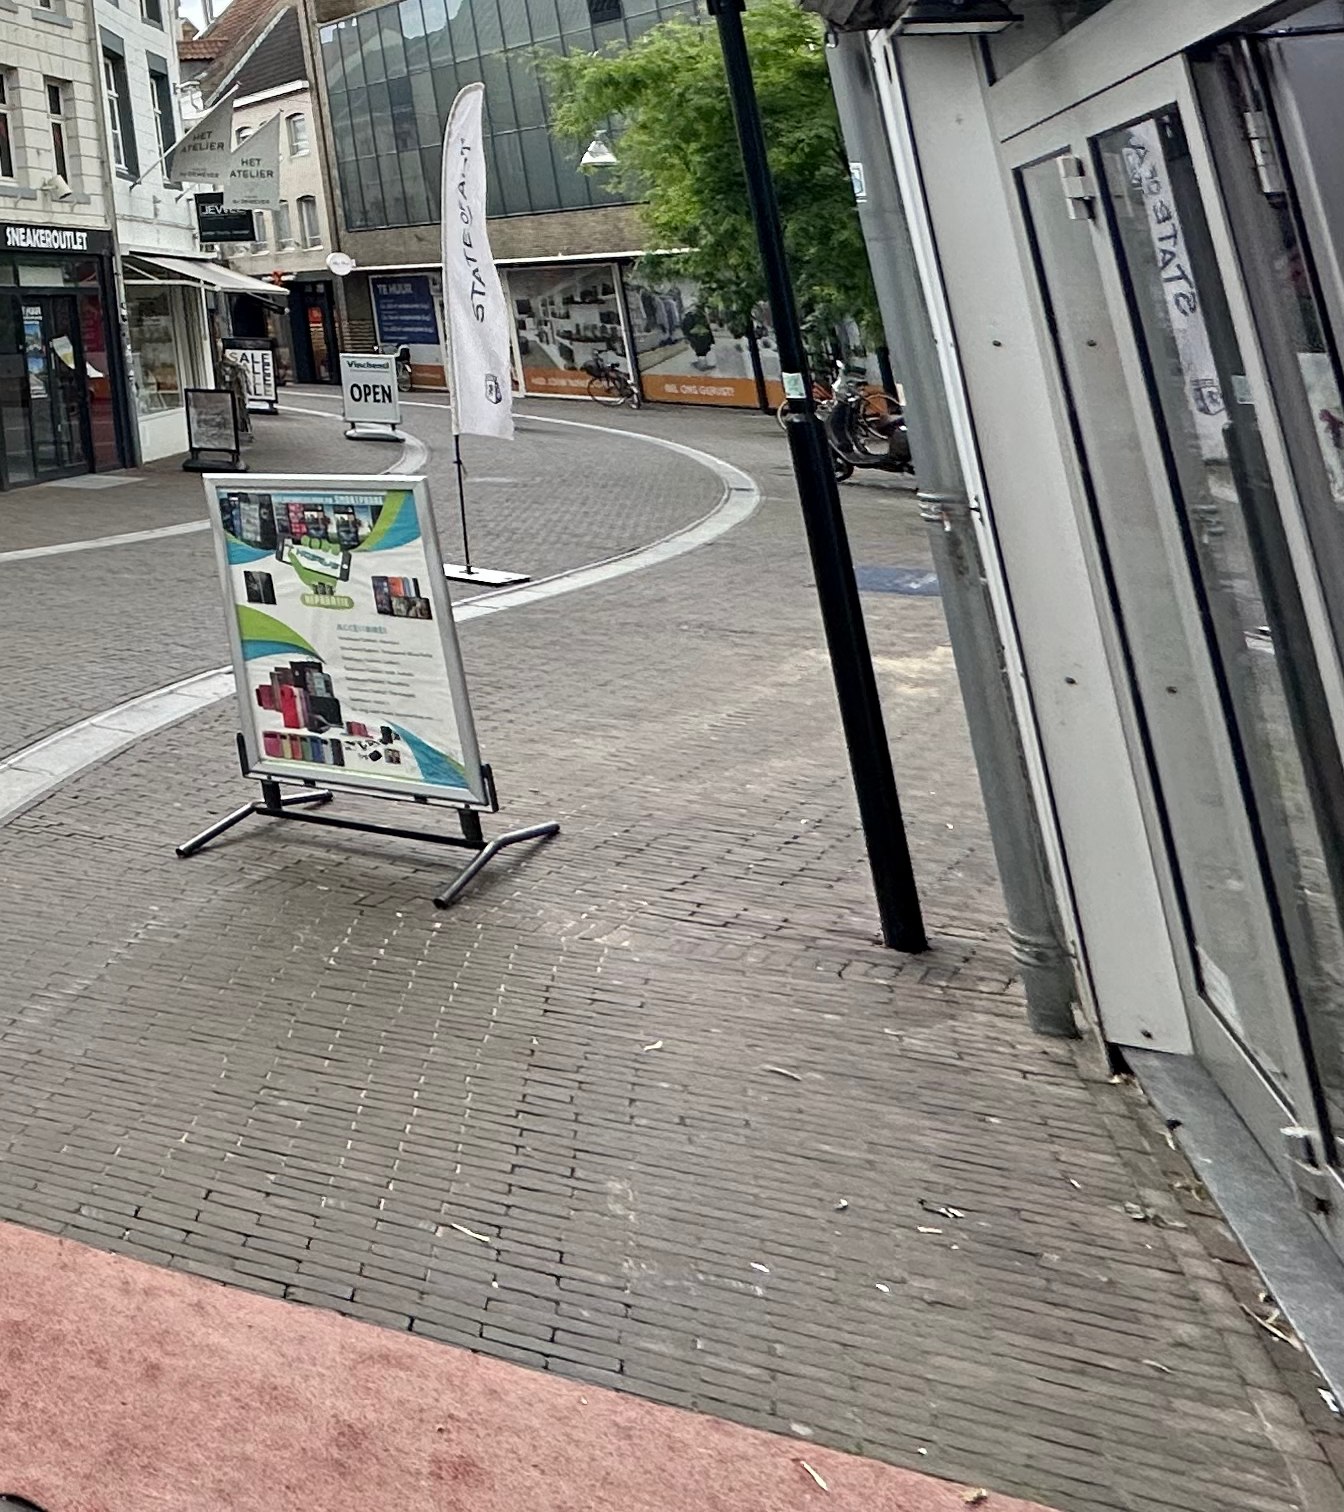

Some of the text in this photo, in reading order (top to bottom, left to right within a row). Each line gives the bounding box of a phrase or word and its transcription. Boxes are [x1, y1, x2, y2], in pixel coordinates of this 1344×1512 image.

[193, 130, 213, 141] HET
[181, 141, 225, 154] ATELIER
[241, 157, 262, 166] HET
[229, 169, 274, 179] ATELIER
[6, 226, 88, 250] SNEAKEROUTLET
[229, 352, 270, 365] SALE
[350, 383, 393, 403] OPEN
